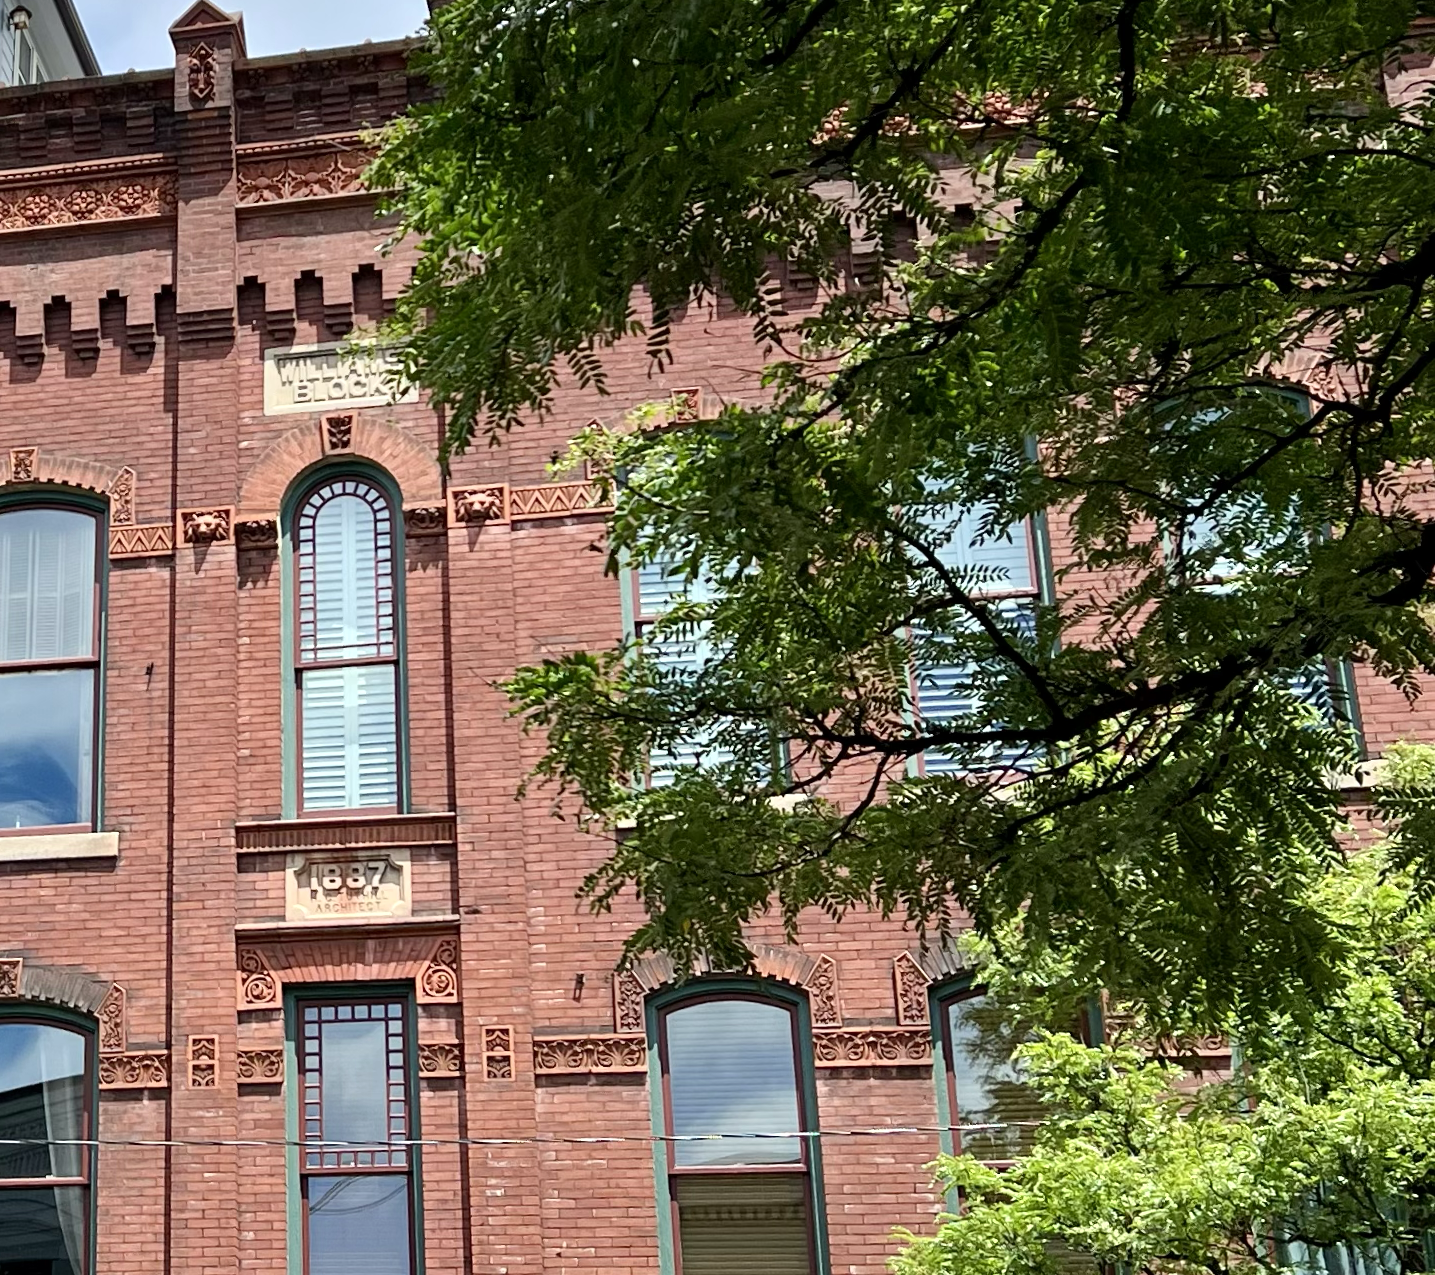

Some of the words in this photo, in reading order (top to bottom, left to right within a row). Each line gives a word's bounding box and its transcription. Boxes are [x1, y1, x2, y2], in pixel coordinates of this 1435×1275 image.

[279, 348, 405, 385] WILLIAMS
[293, 374, 391, 403] BLOCK
[310, 860, 389, 892] 1887
[315, 901, 382, 913] ARCHITECT
